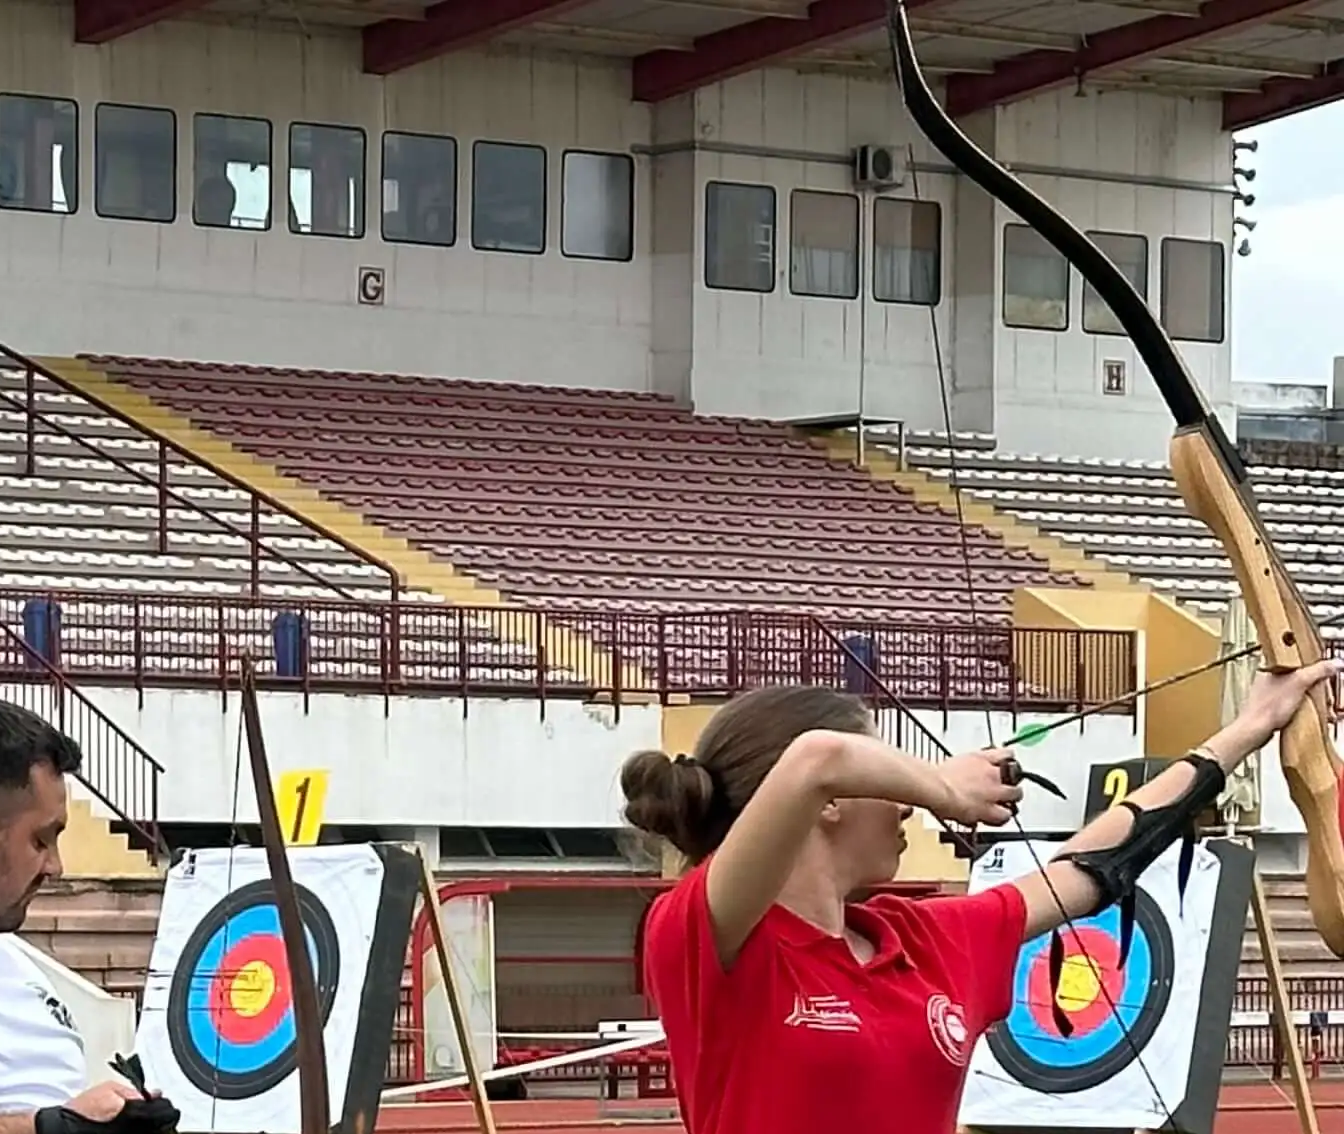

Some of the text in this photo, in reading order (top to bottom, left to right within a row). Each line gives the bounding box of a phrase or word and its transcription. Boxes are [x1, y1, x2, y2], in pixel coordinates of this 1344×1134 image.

[362, 271, 382, 300] G
[1106, 364, 1121, 391] H
[291, 776, 311, 843] 1
